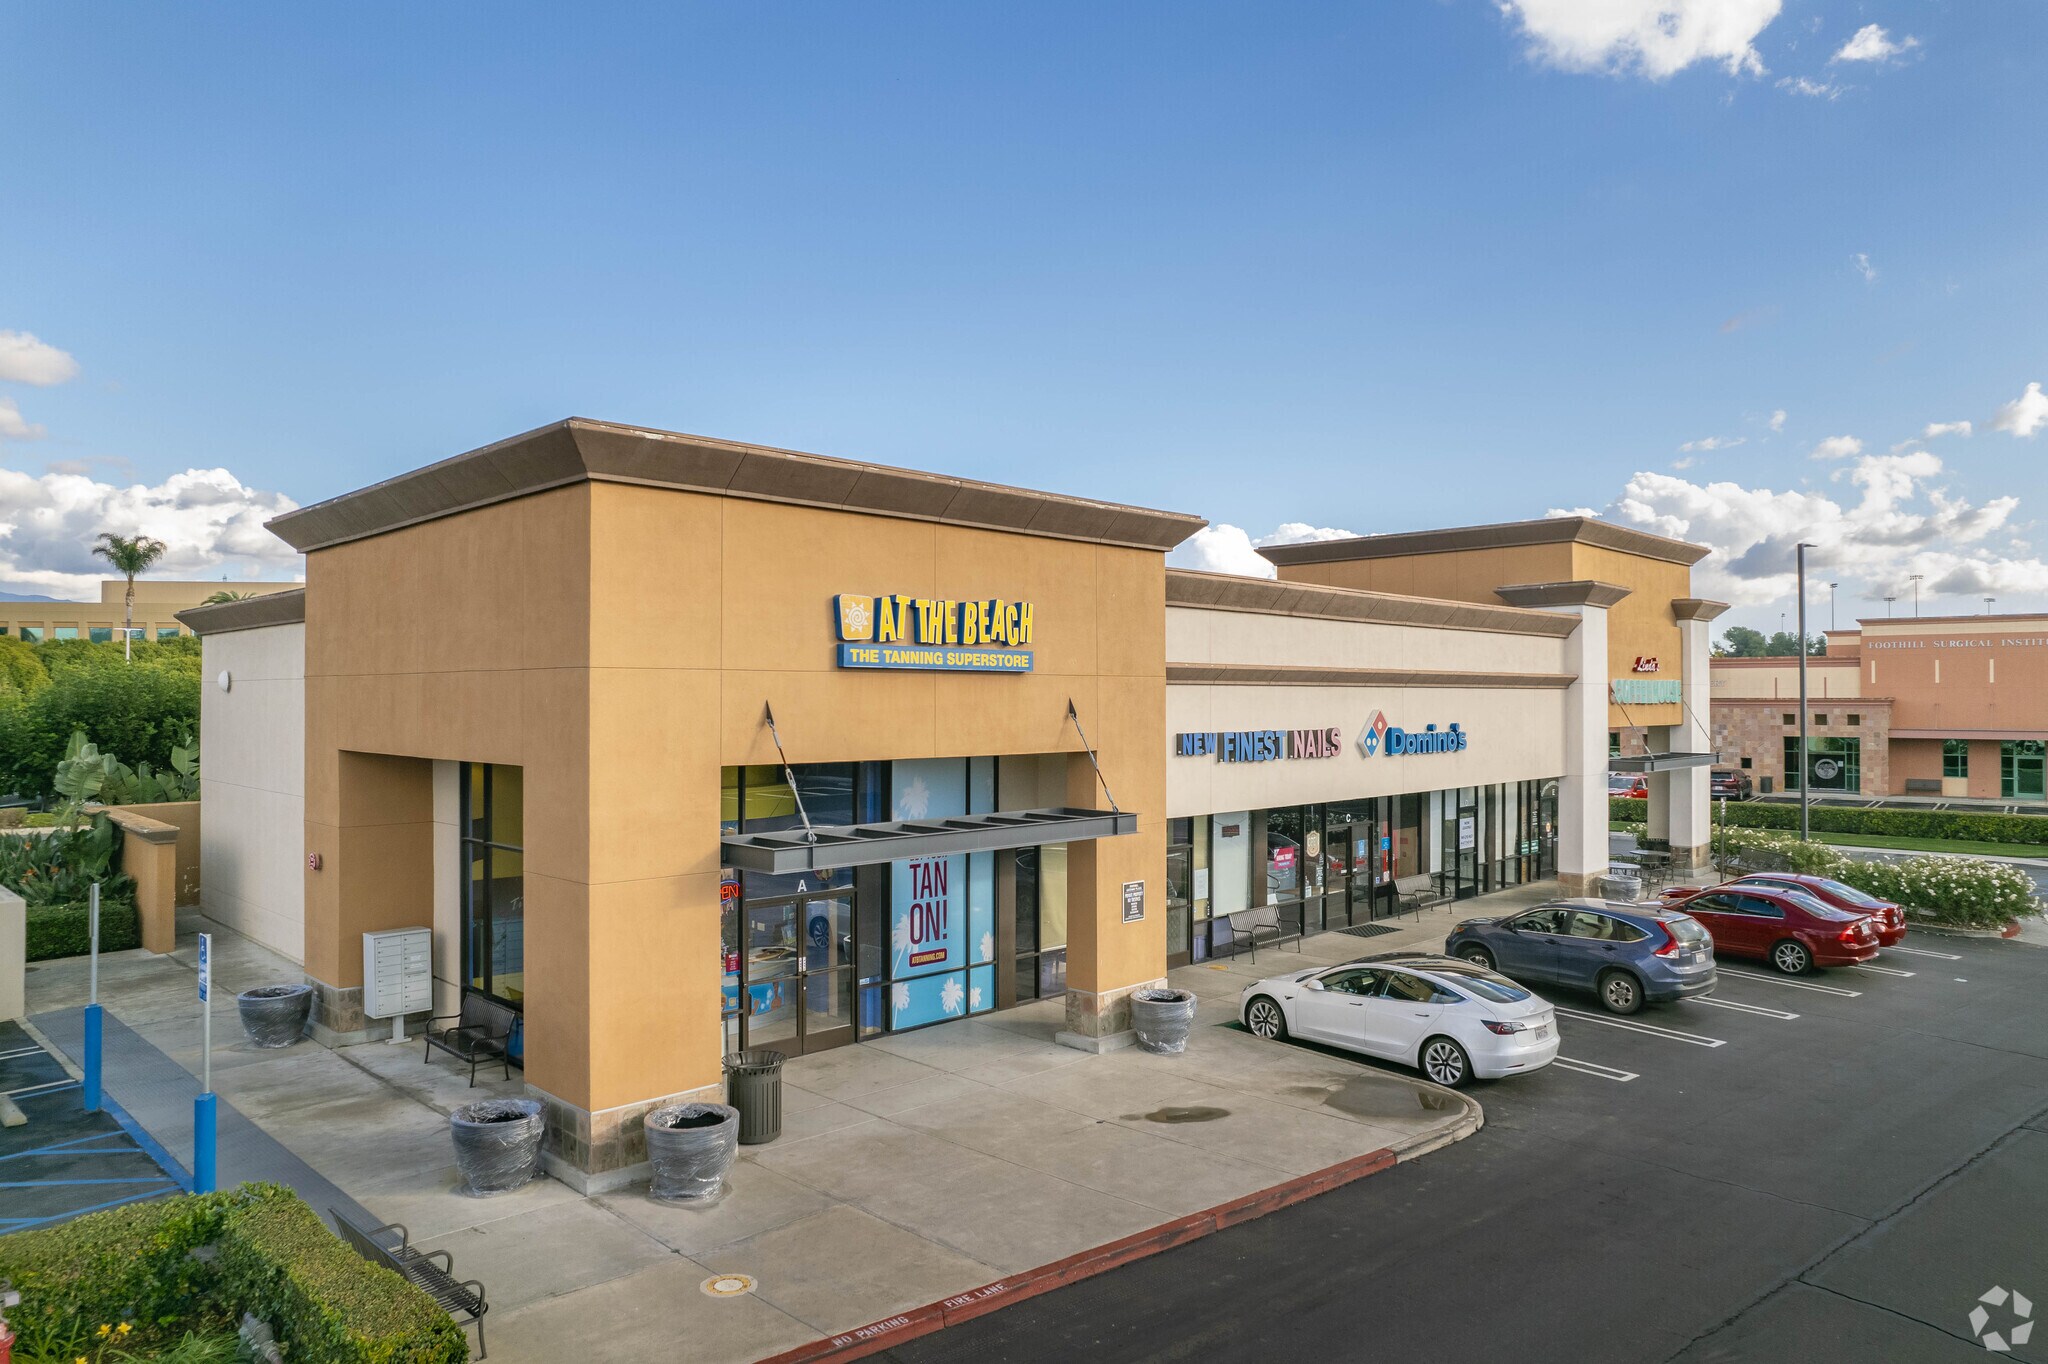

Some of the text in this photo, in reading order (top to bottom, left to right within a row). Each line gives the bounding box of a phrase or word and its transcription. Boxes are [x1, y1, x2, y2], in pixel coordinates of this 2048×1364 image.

[878, 594, 1034, 646] AT THE BEACH
[850, 648, 1029, 667] THE TANNING SUPERSTORE
[1868, 641, 1926, 649] FOOTHILL
[1933, 639, 1993, 648] SURGICAL
[1181, 727, 1342, 762] NEW FINEST NAILS
[1389, 723, 1467, 754] Domino's
[1346, 813, 1351, 823] C
[720, 884, 739, 900] EN
[797, 879, 807, 893] A
[909, 861, 947, 900] TAN
[910, 900, 947, 944] ON!
[943, 1283, 1008, 1308] FIRE LANE
[832, 1316, 909, 1347] NO PARKING
